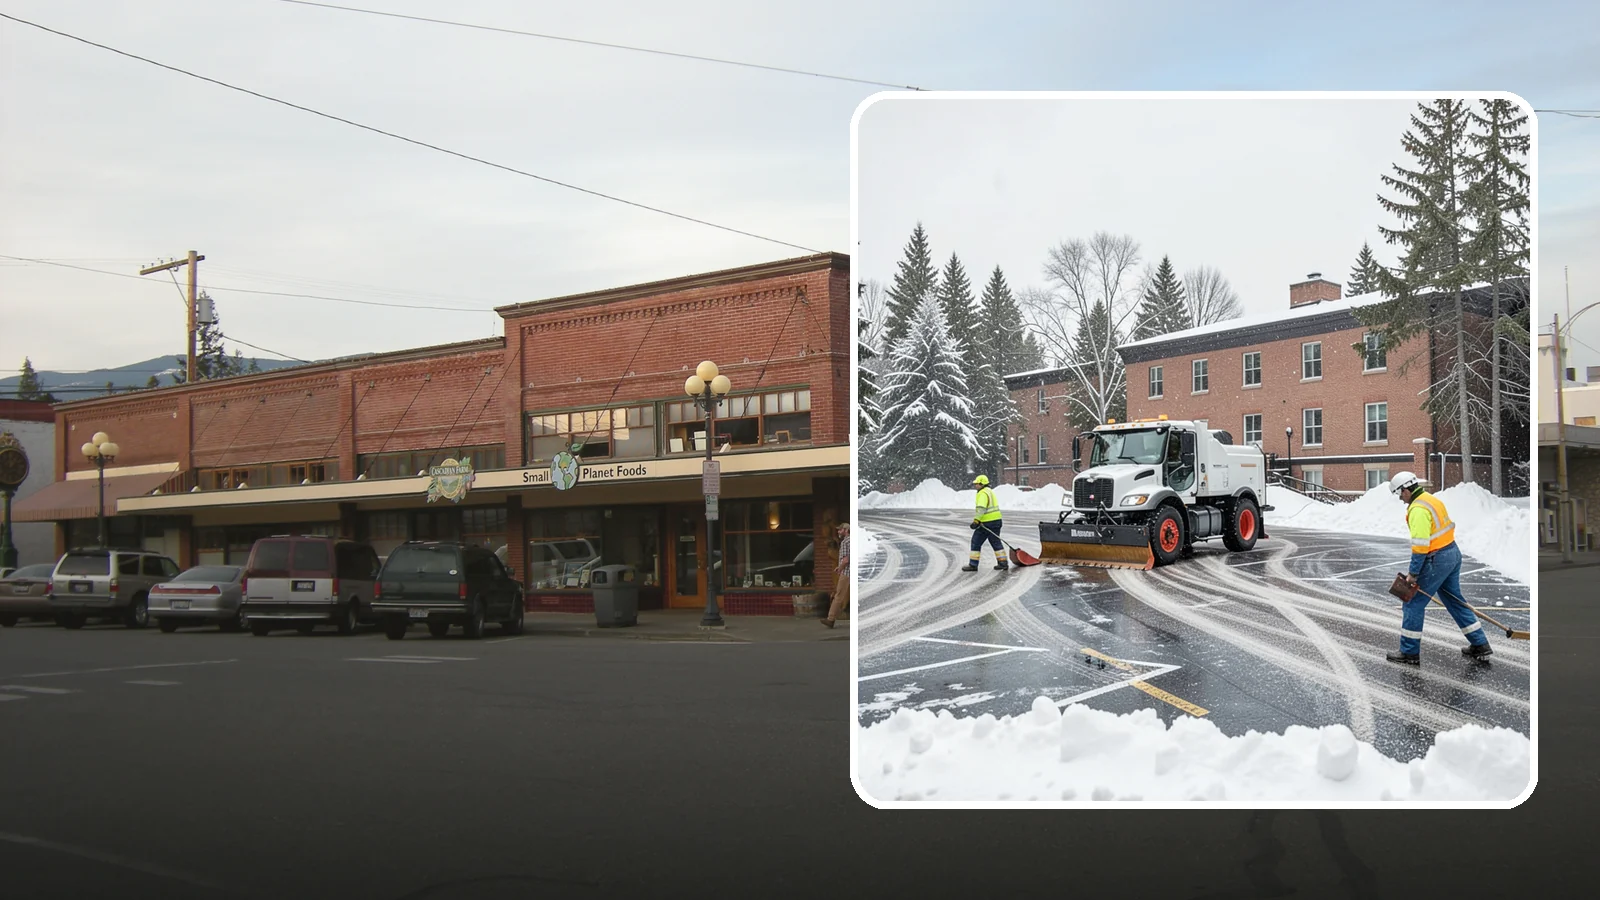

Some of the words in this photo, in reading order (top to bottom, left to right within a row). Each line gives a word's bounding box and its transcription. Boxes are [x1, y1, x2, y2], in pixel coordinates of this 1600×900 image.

[523, 471, 549, 483] Small
[583, 467, 614, 479] Planet
[617, 464, 647, 477] Foods
